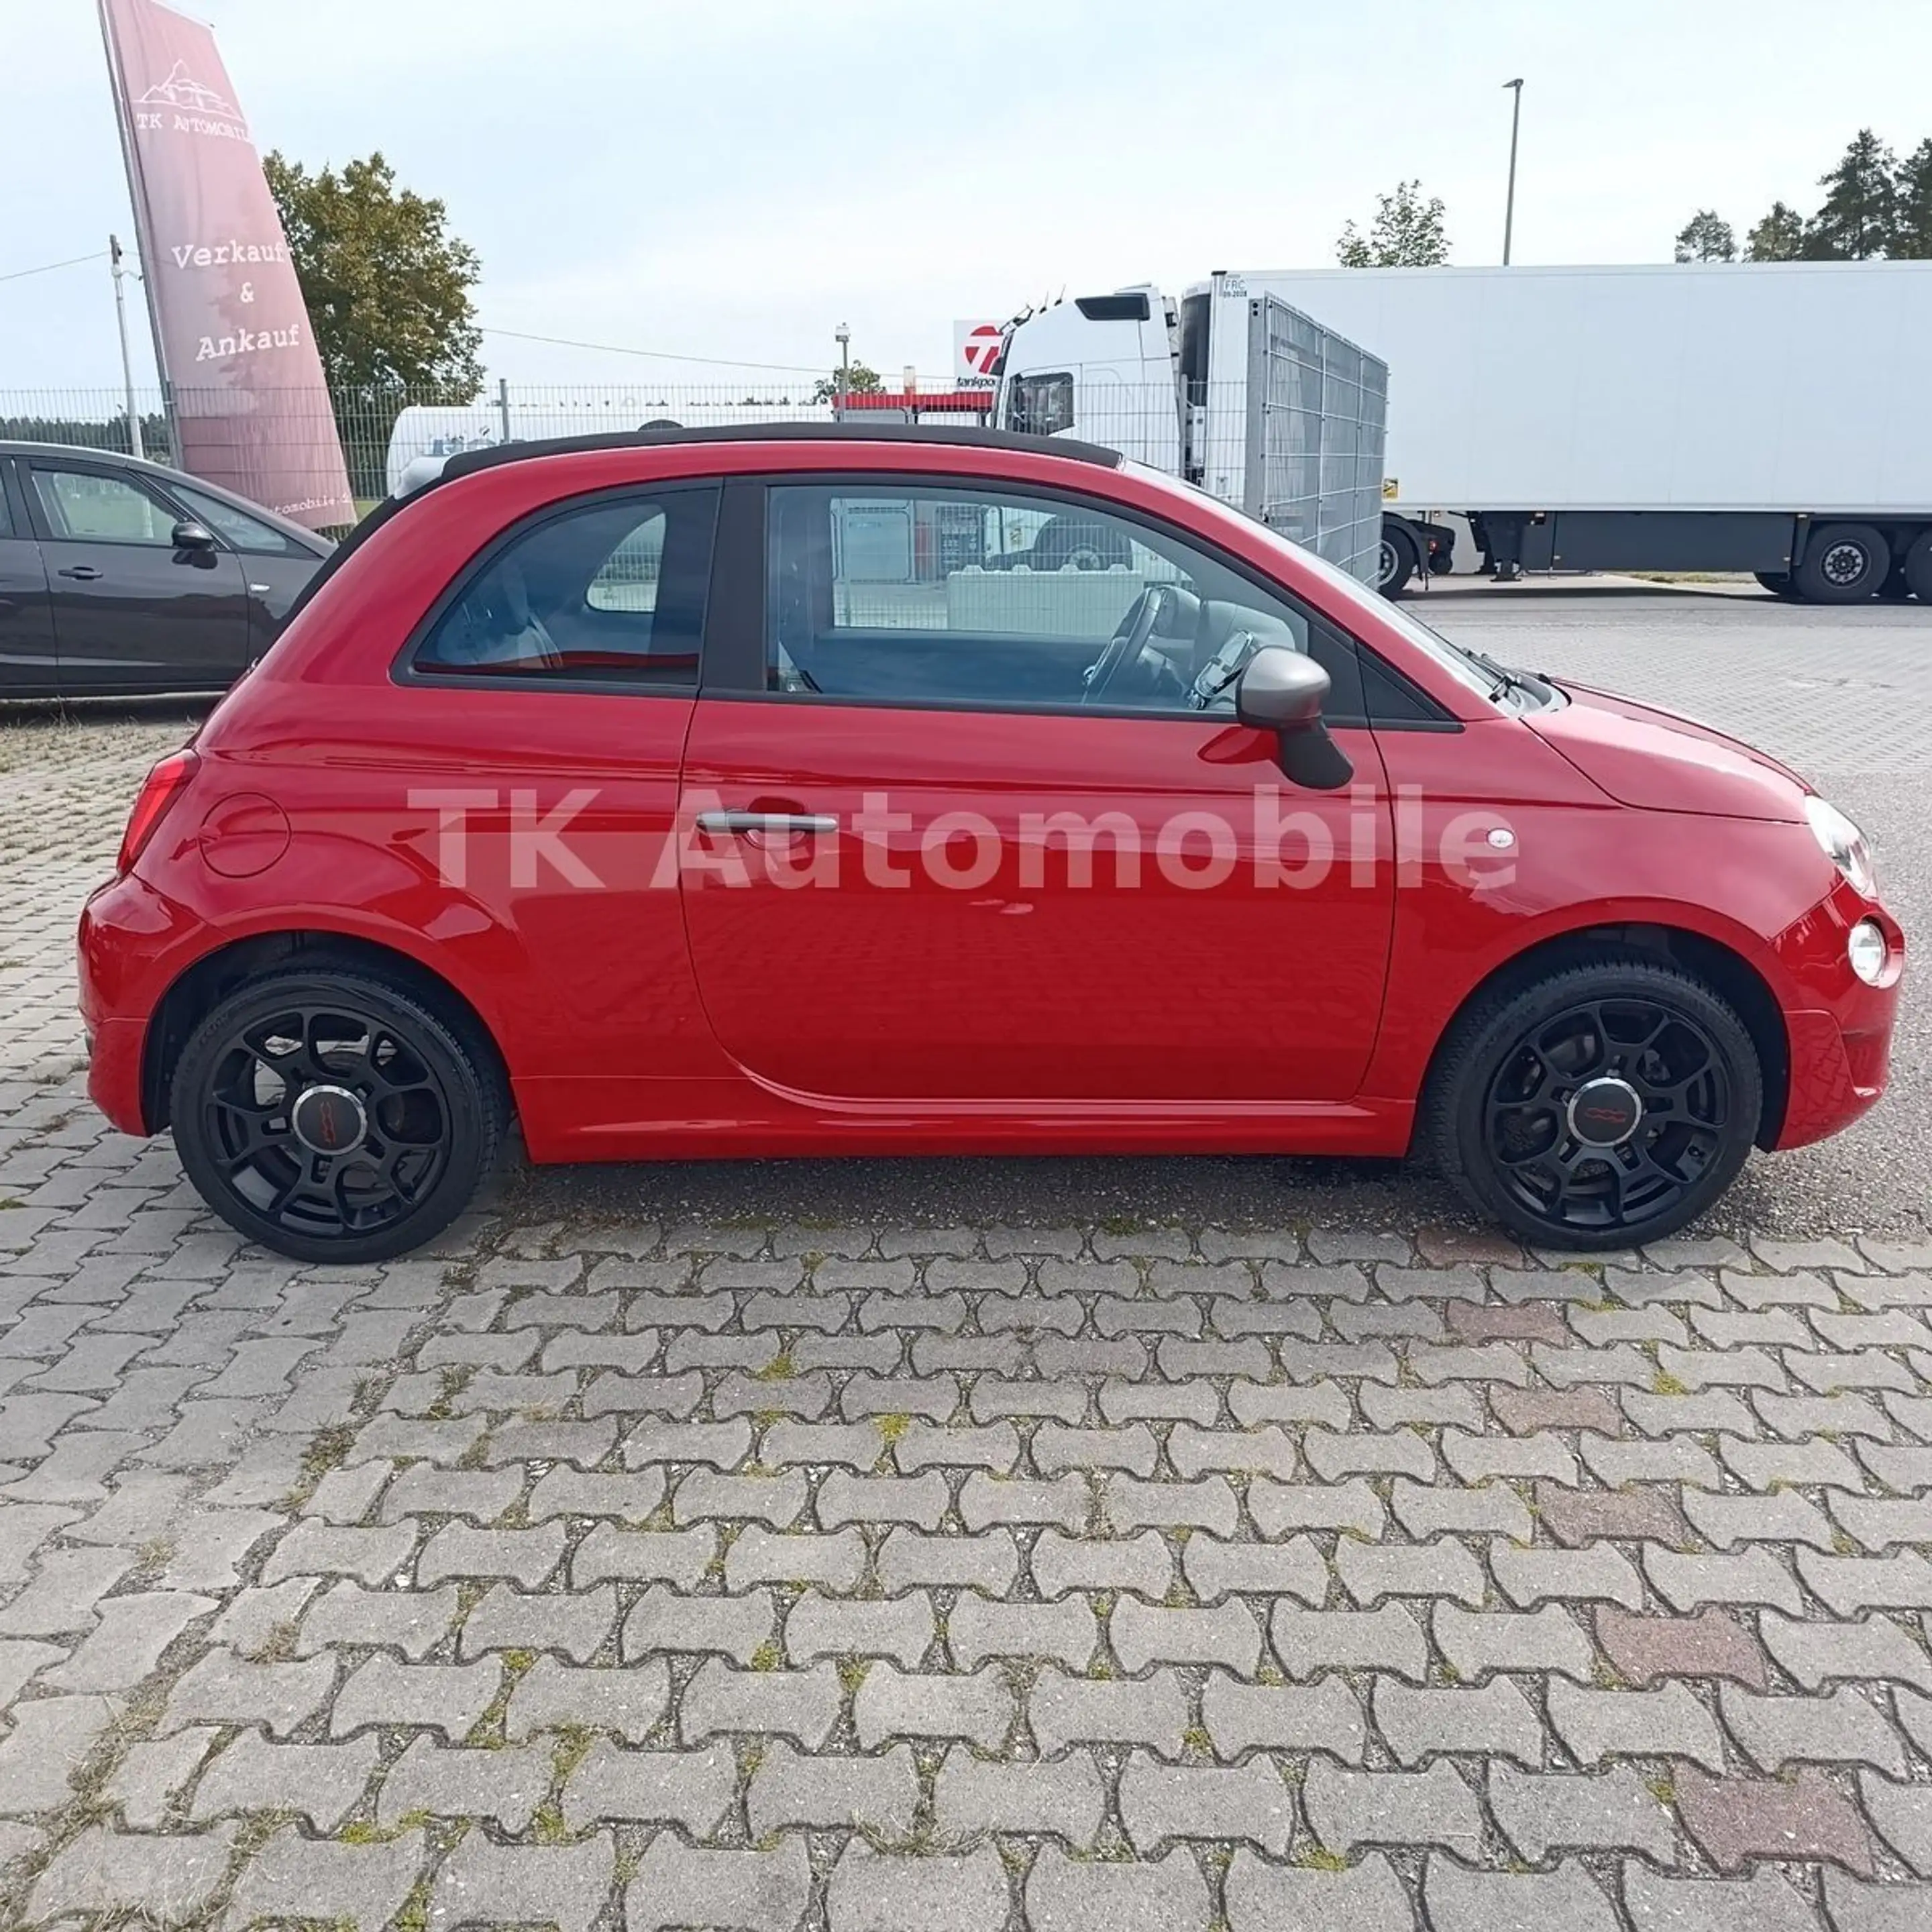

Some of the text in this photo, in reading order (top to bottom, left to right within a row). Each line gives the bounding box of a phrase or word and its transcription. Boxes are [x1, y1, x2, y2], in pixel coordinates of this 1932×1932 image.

[137, 113, 163, 129] TK
[171, 239, 285, 269] Verkauf
[240, 282, 255, 303] &
[1224, 279, 1246, 290] FRC
[195, 324, 300, 362] Ankauf
